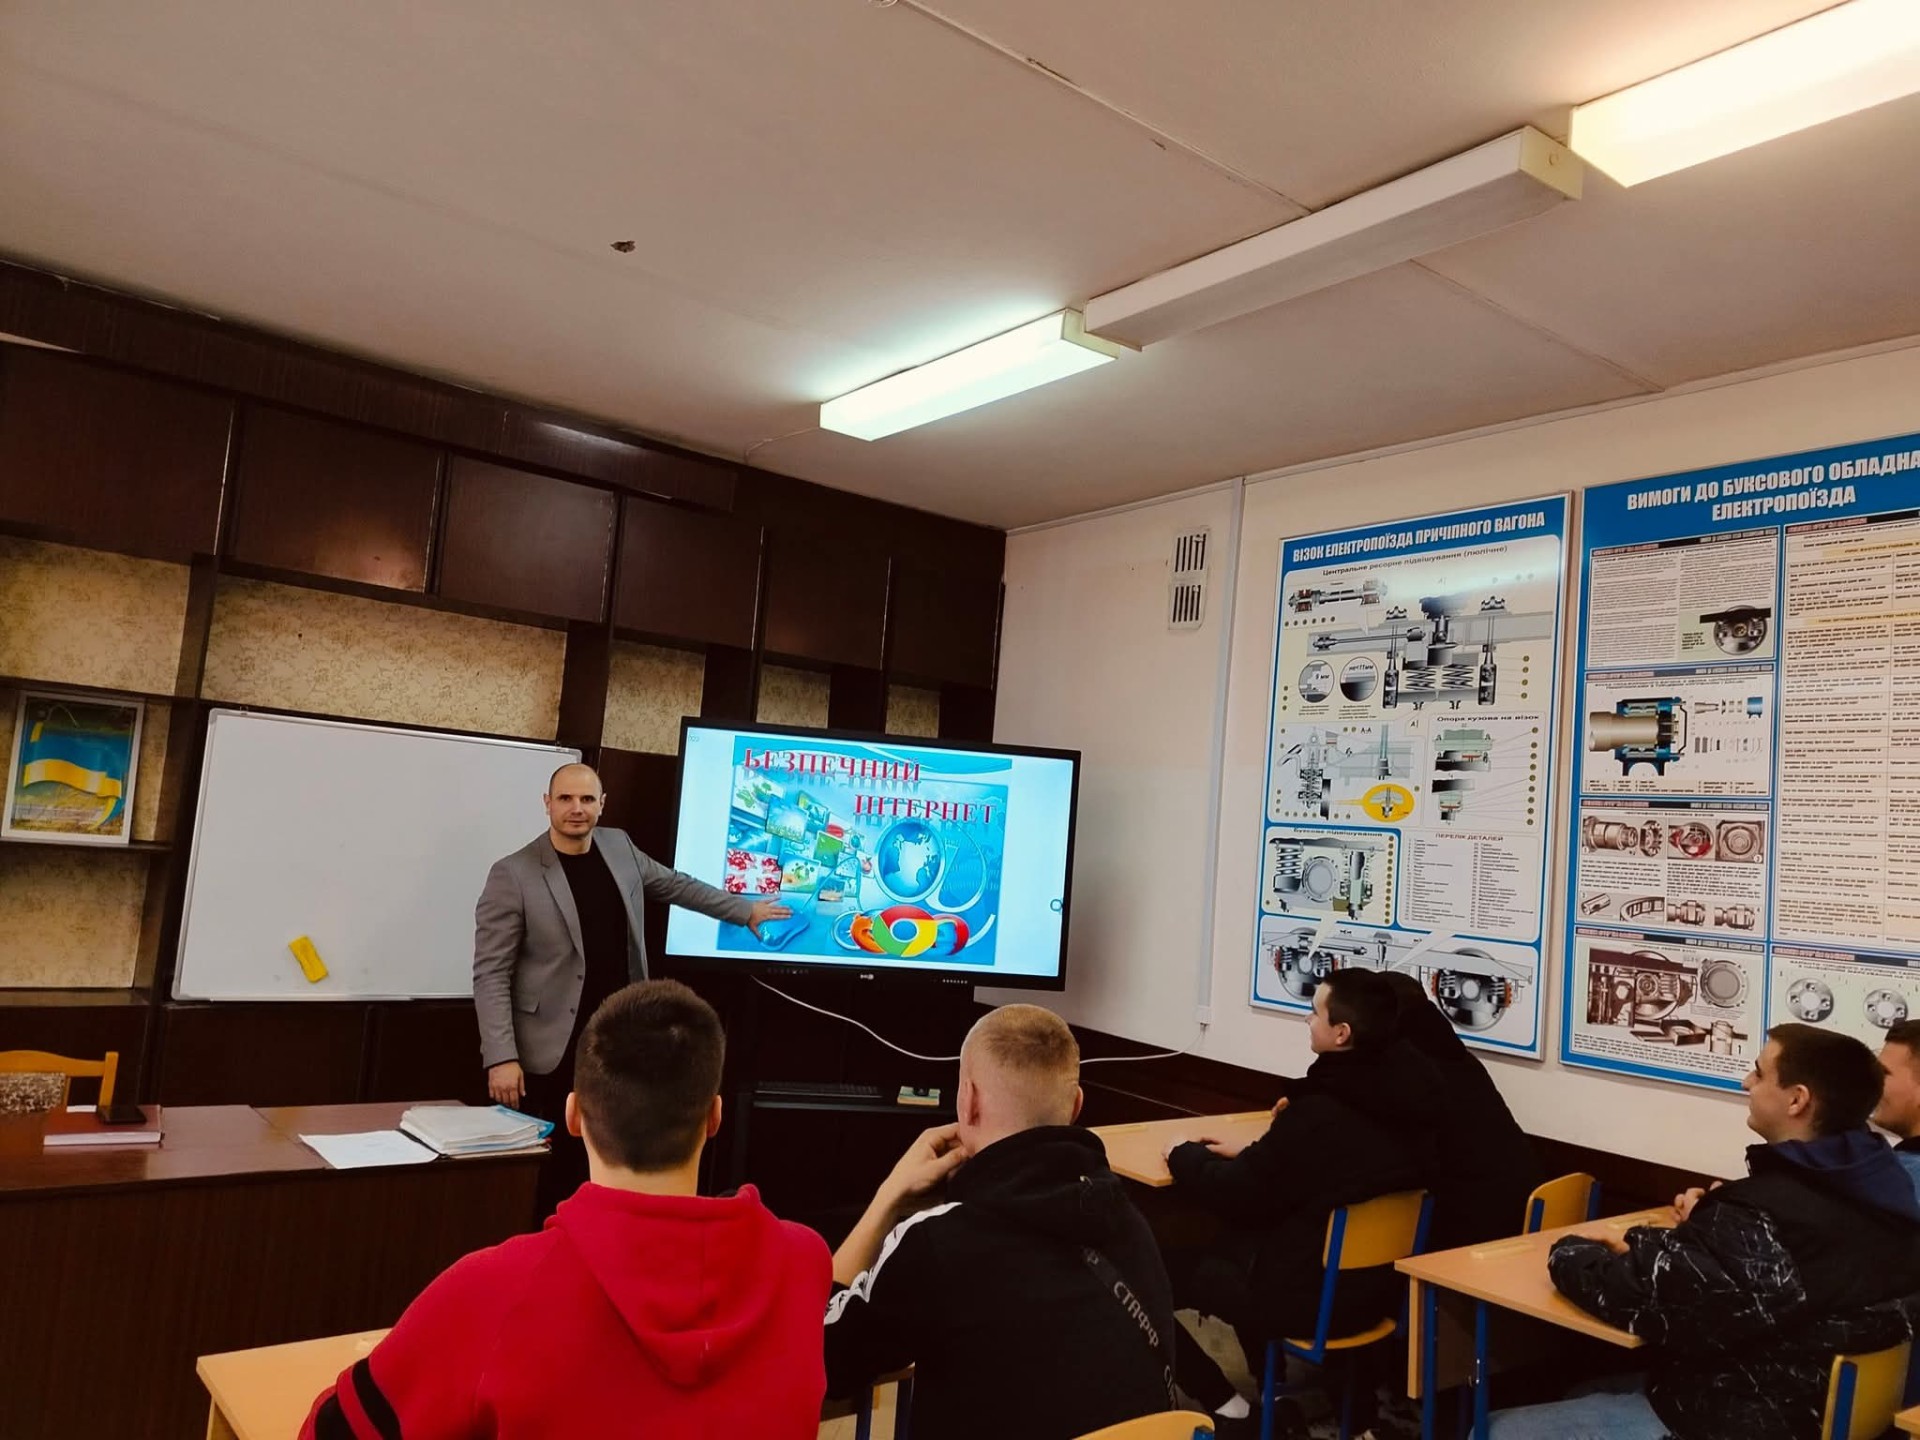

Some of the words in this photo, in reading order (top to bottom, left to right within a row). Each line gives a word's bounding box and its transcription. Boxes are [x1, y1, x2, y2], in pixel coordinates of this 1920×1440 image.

[1627, 485, 1691, 511] ВИМОГИ
[1694, 481, 1719, 503] ДО
[1722, 464, 1825, 496] БУКСОВОГО
[1828, 449, 1920, 481] ОБЛАДНА
[1712, 485, 1856, 522] ЕЛЕКТРОПОЇЗДА
[1292, 544, 1325, 563] ВІЗОК
[1325, 532, 1413, 558] ЕЛЕКТРОПОЇЗДА
[1415, 519, 1492, 545] ПРИЧІПНОГО
[1494, 511, 1545, 533] ВАГОНА
[744, 748, 921, 782] БЕЗПЕЧНИЙ
[855, 794, 998, 824] ІНТЕРНЕТ
